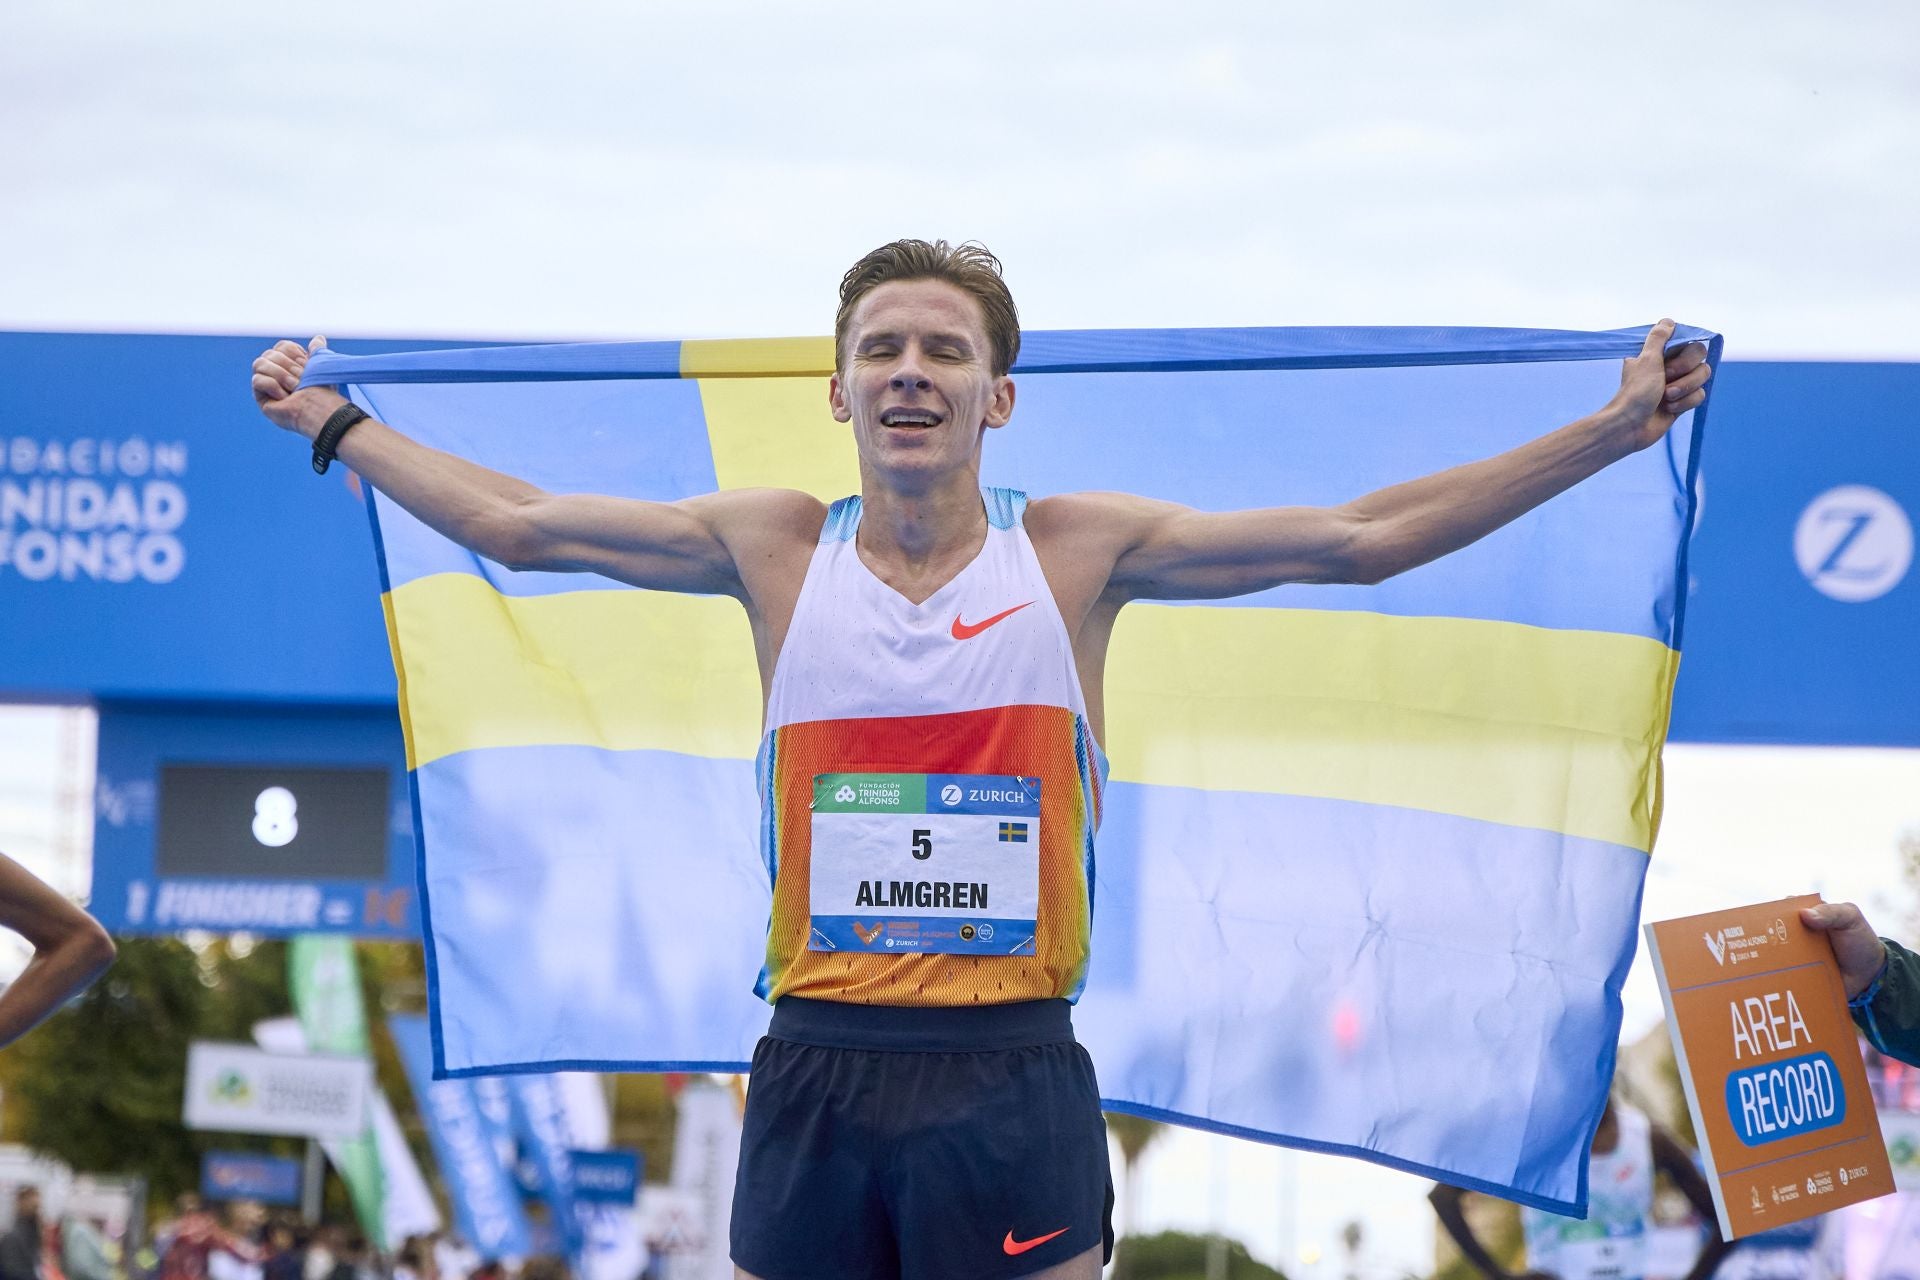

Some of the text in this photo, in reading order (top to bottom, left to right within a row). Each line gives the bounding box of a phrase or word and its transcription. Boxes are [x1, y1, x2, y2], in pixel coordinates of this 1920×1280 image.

[0, 434, 188, 477] DACIÓN
[858, 789, 901, 798] TRINIDAD
[858, 797, 901, 805] ALFONSO
[969, 789, 1025, 804] ZURICH
[252, 786, 298, 847] 8
[911, 829, 933, 861] 5
[855, 880, 988, 909] ALMGREN
[1729, 990, 1812, 1059] AREA
[1738, 1059, 1835, 1137] RECORD
[1848, 1166, 1869, 1180] ZURICH
